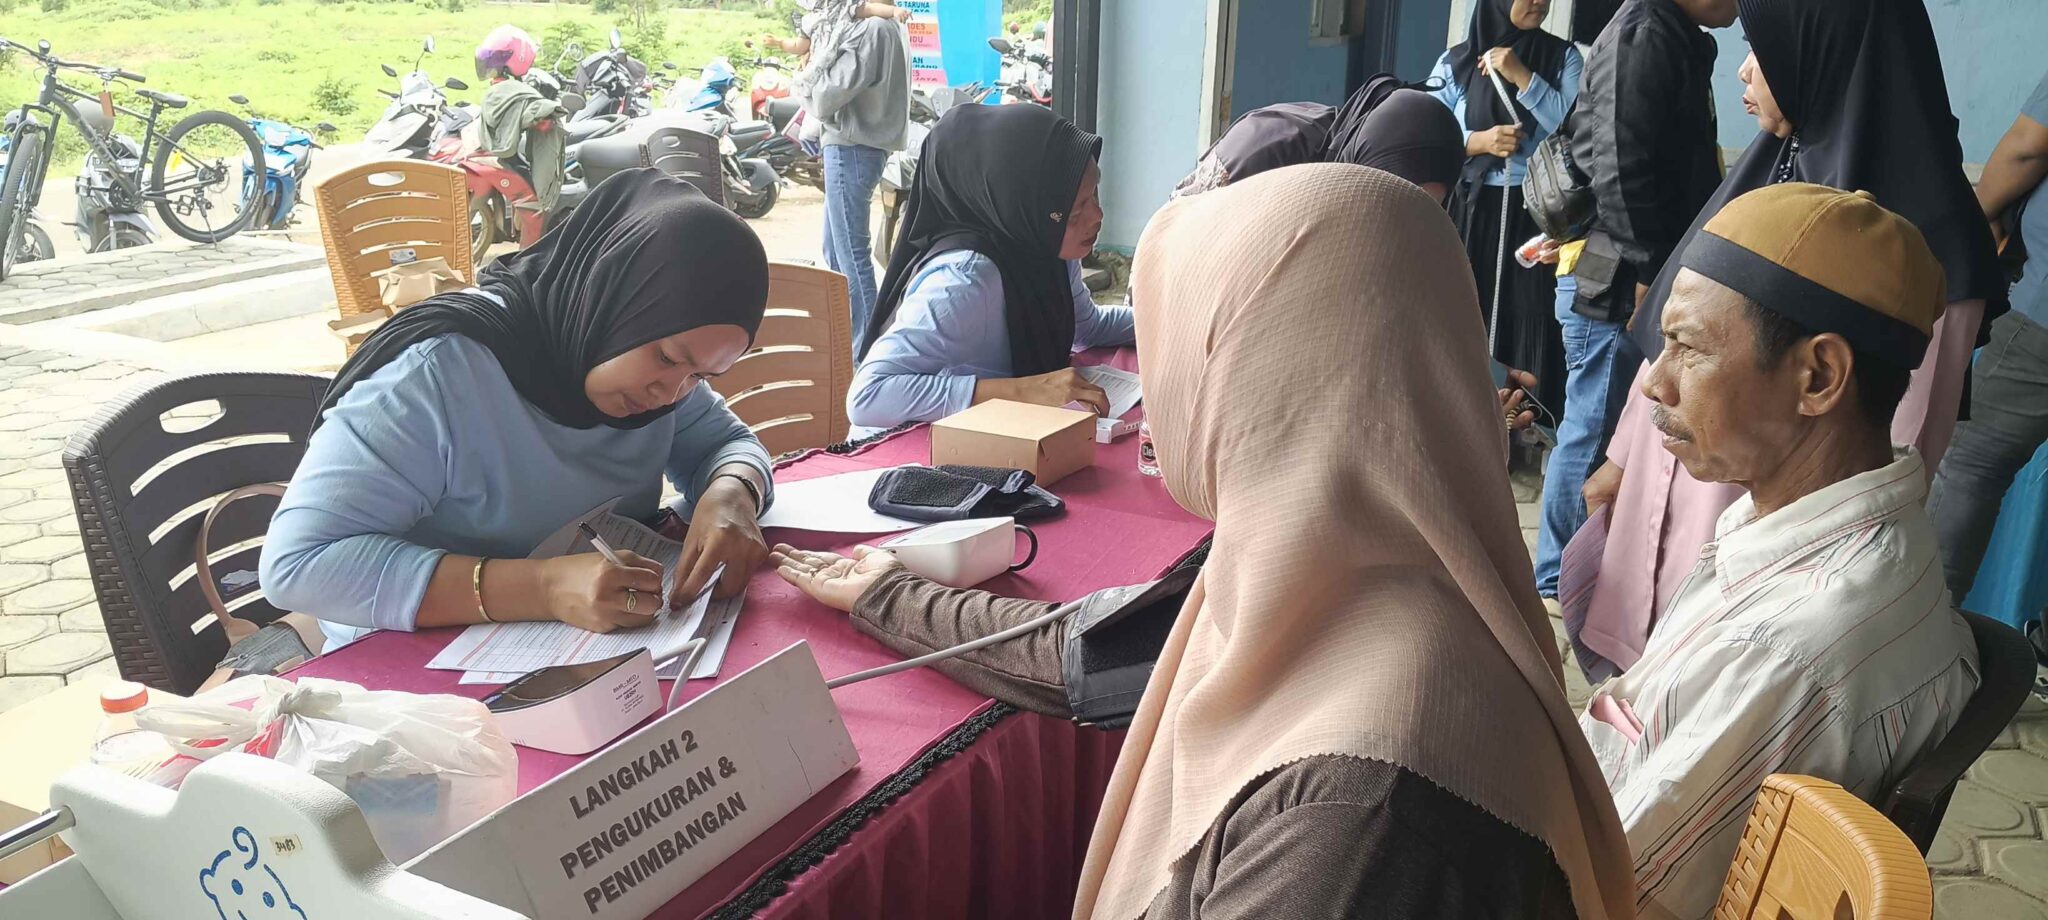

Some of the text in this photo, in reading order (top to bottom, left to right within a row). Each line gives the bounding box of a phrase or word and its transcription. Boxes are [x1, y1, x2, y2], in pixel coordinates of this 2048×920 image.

[559, 756, 738, 880] PENGUKURAN &
[569, 729, 699, 820] LANGKAH 2
[583, 791, 748, 915] PENIMBANGAN
